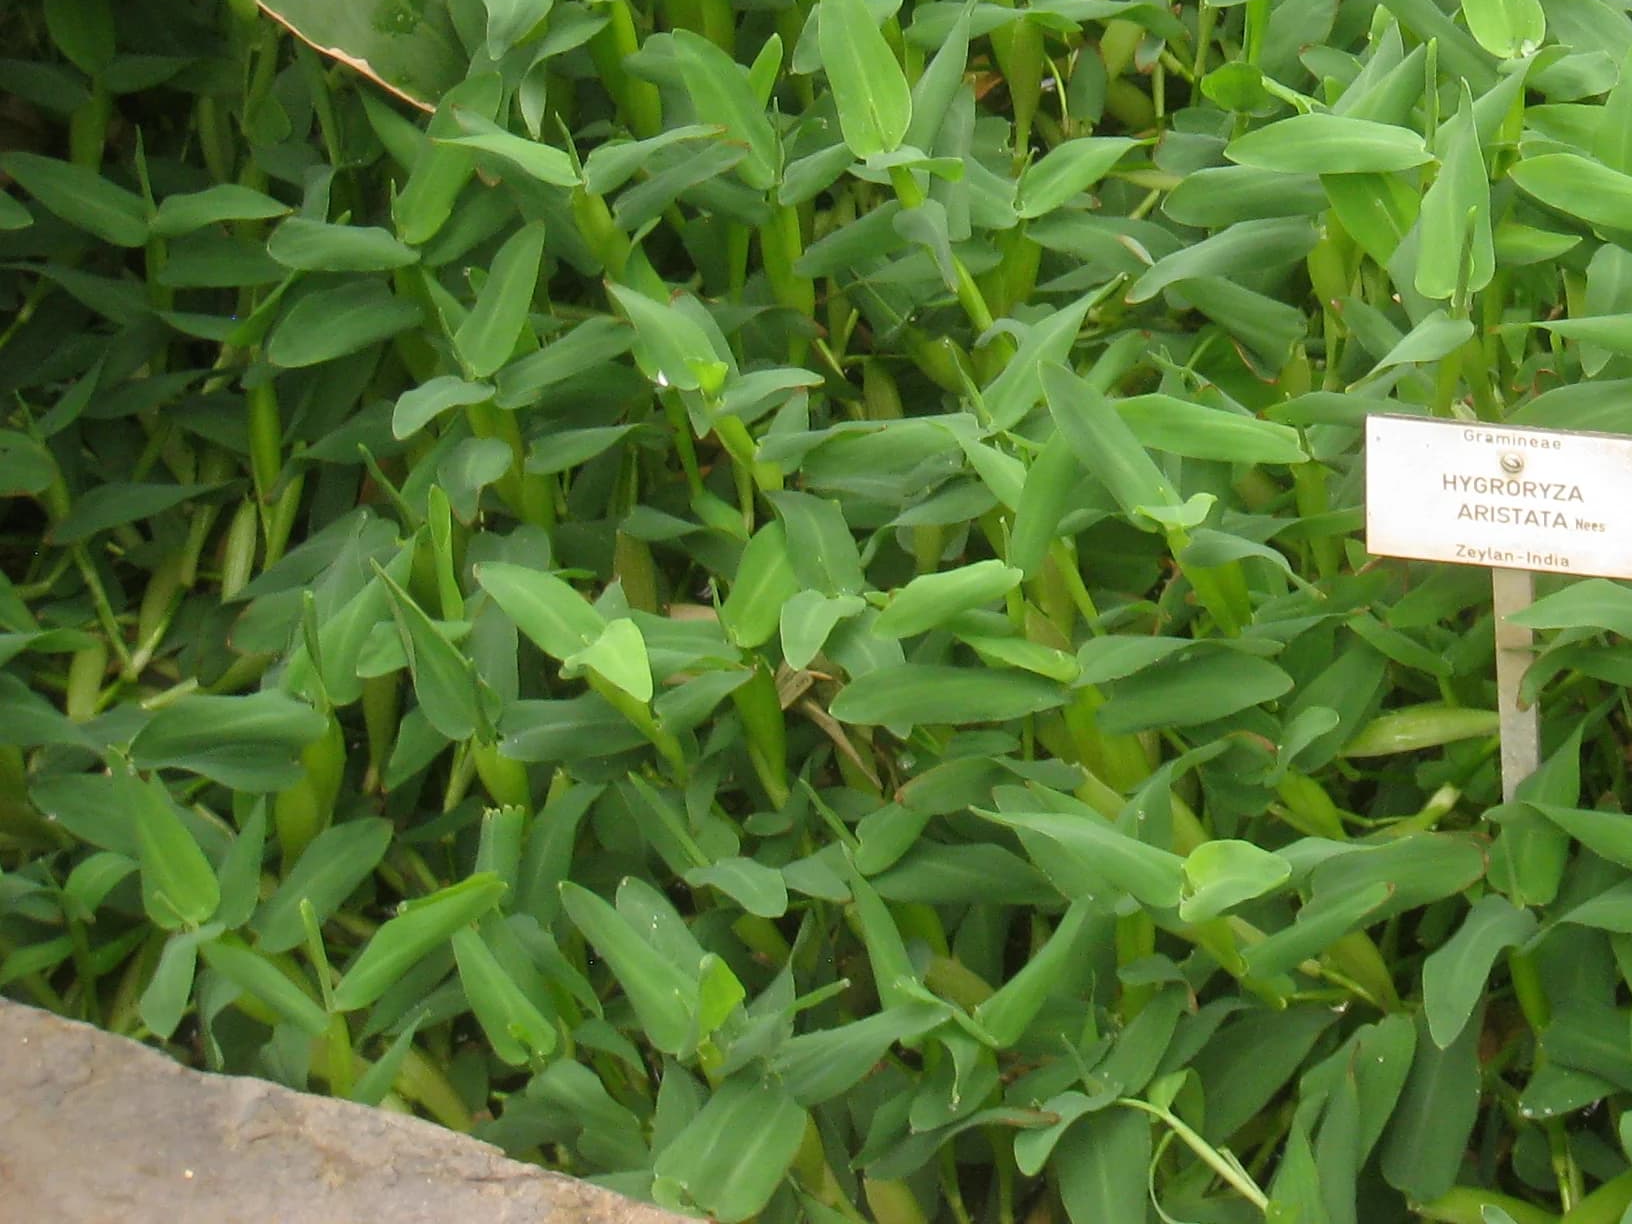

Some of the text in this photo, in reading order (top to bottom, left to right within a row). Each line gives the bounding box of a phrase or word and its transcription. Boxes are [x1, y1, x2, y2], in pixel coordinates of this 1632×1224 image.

[1463, 428, 1562, 450] Gramineae
[1442, 473, 1585, 503] HYGRORYZA
[1456, 503, 1606, 533] ARISTATA Nees
[1455, 543, 1570, 568] Zeylan-India
